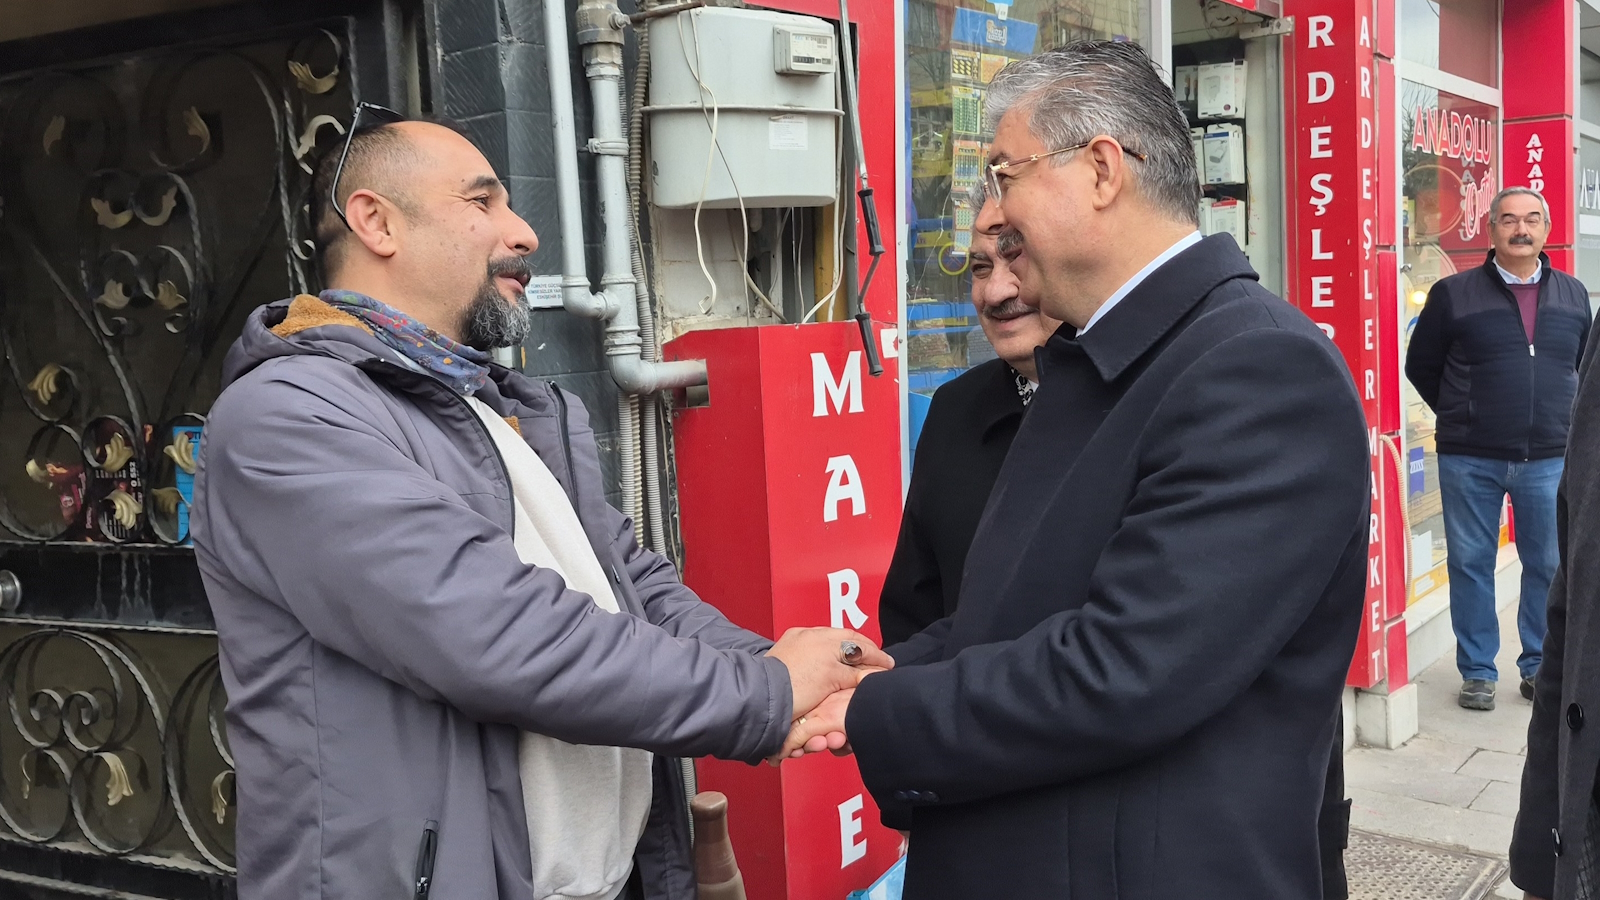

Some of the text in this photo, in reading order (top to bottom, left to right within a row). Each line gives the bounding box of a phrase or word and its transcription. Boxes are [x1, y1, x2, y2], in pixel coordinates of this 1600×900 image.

[1359, 15, 1376, 400] ARDEŞLER
[1411, 105, 1492, 165] ANADOLU
[809, 351, 868, 869] MARE
